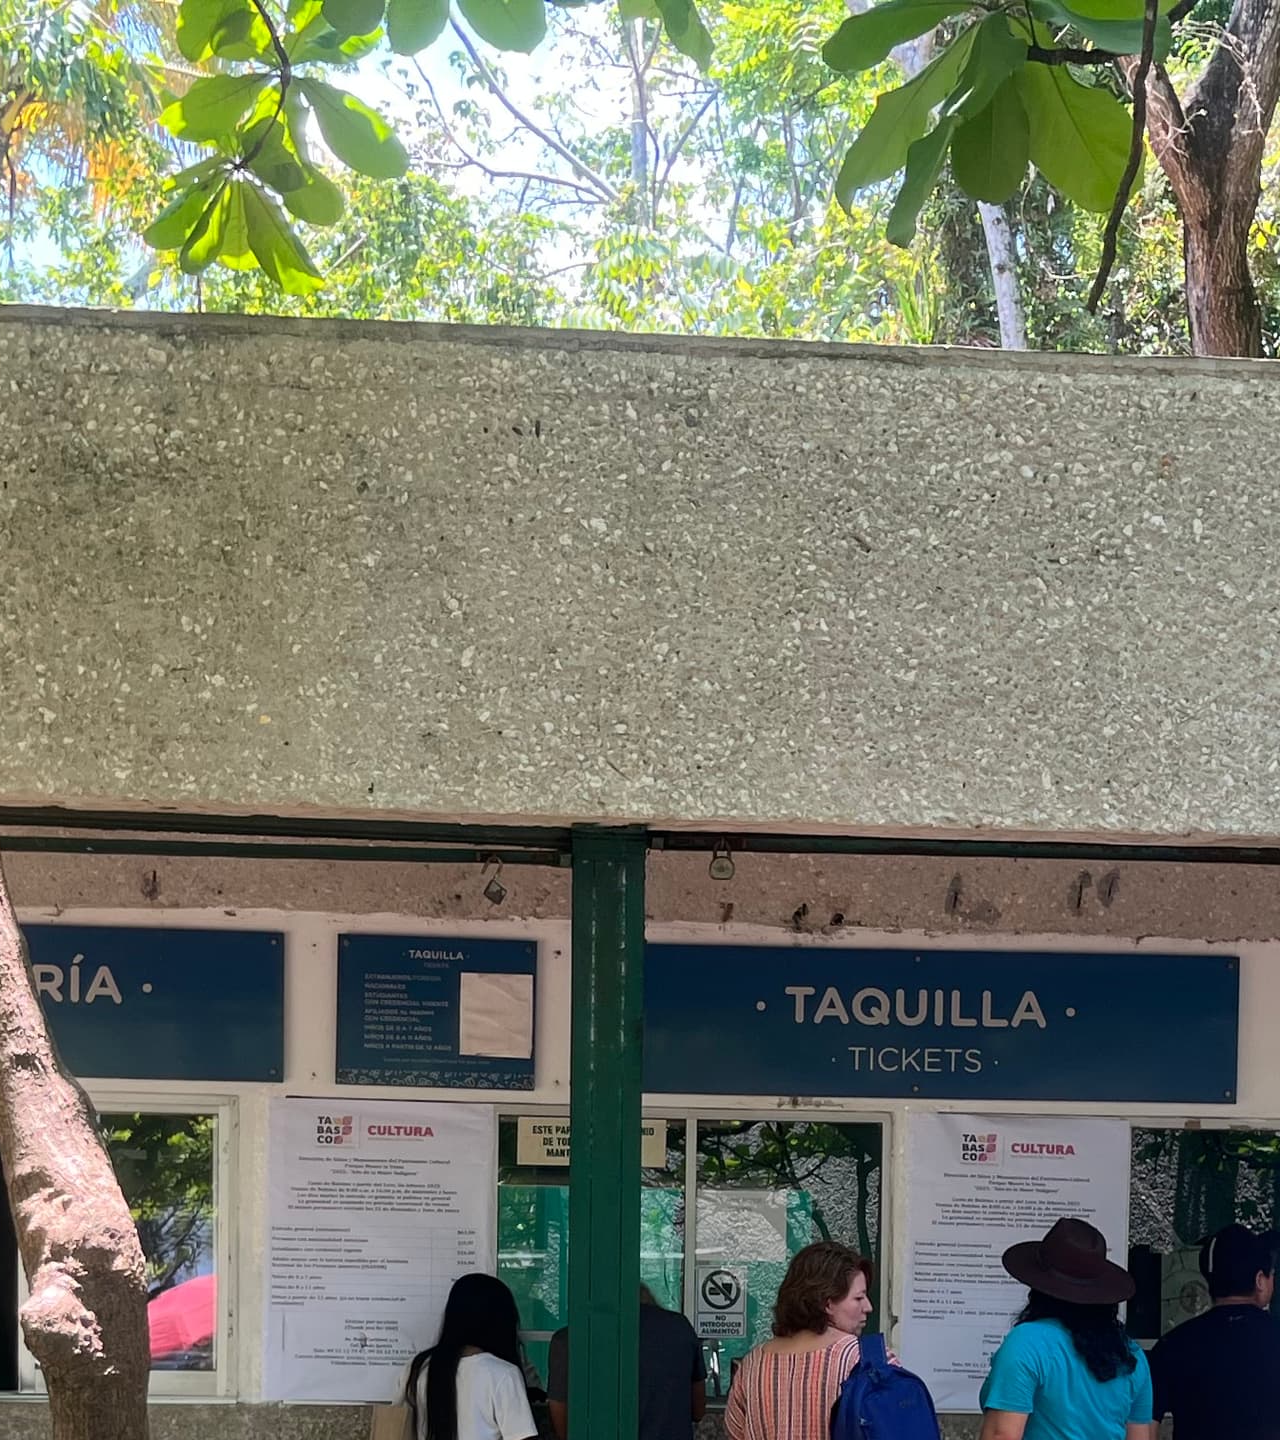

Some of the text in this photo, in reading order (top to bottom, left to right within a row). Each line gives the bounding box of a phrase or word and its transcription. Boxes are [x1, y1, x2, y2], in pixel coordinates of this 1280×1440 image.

[408, 949, 464, 961] TAQUILLA
[785, 986, 1047, 1029] TAQUILLA
[848, 1047, 982, 1073] TICKETS
[318, 1116, 332, 1125] TA
[317, 1126, 341, 1135] BAS
[367, 1125, 434, 1137] CULTURA
[532, 1125, 553, 1134] ESTE
[317, 1135, 333, 1144] CO
[543, 1137, 553, 1146] DE
[962, 1134, 977, 1143] TA
[962, 1144, 985, 1152] BAS
[1011, 1143, 1075, 1155] CULTURA
[962, 1153, 977, 1161] CO
